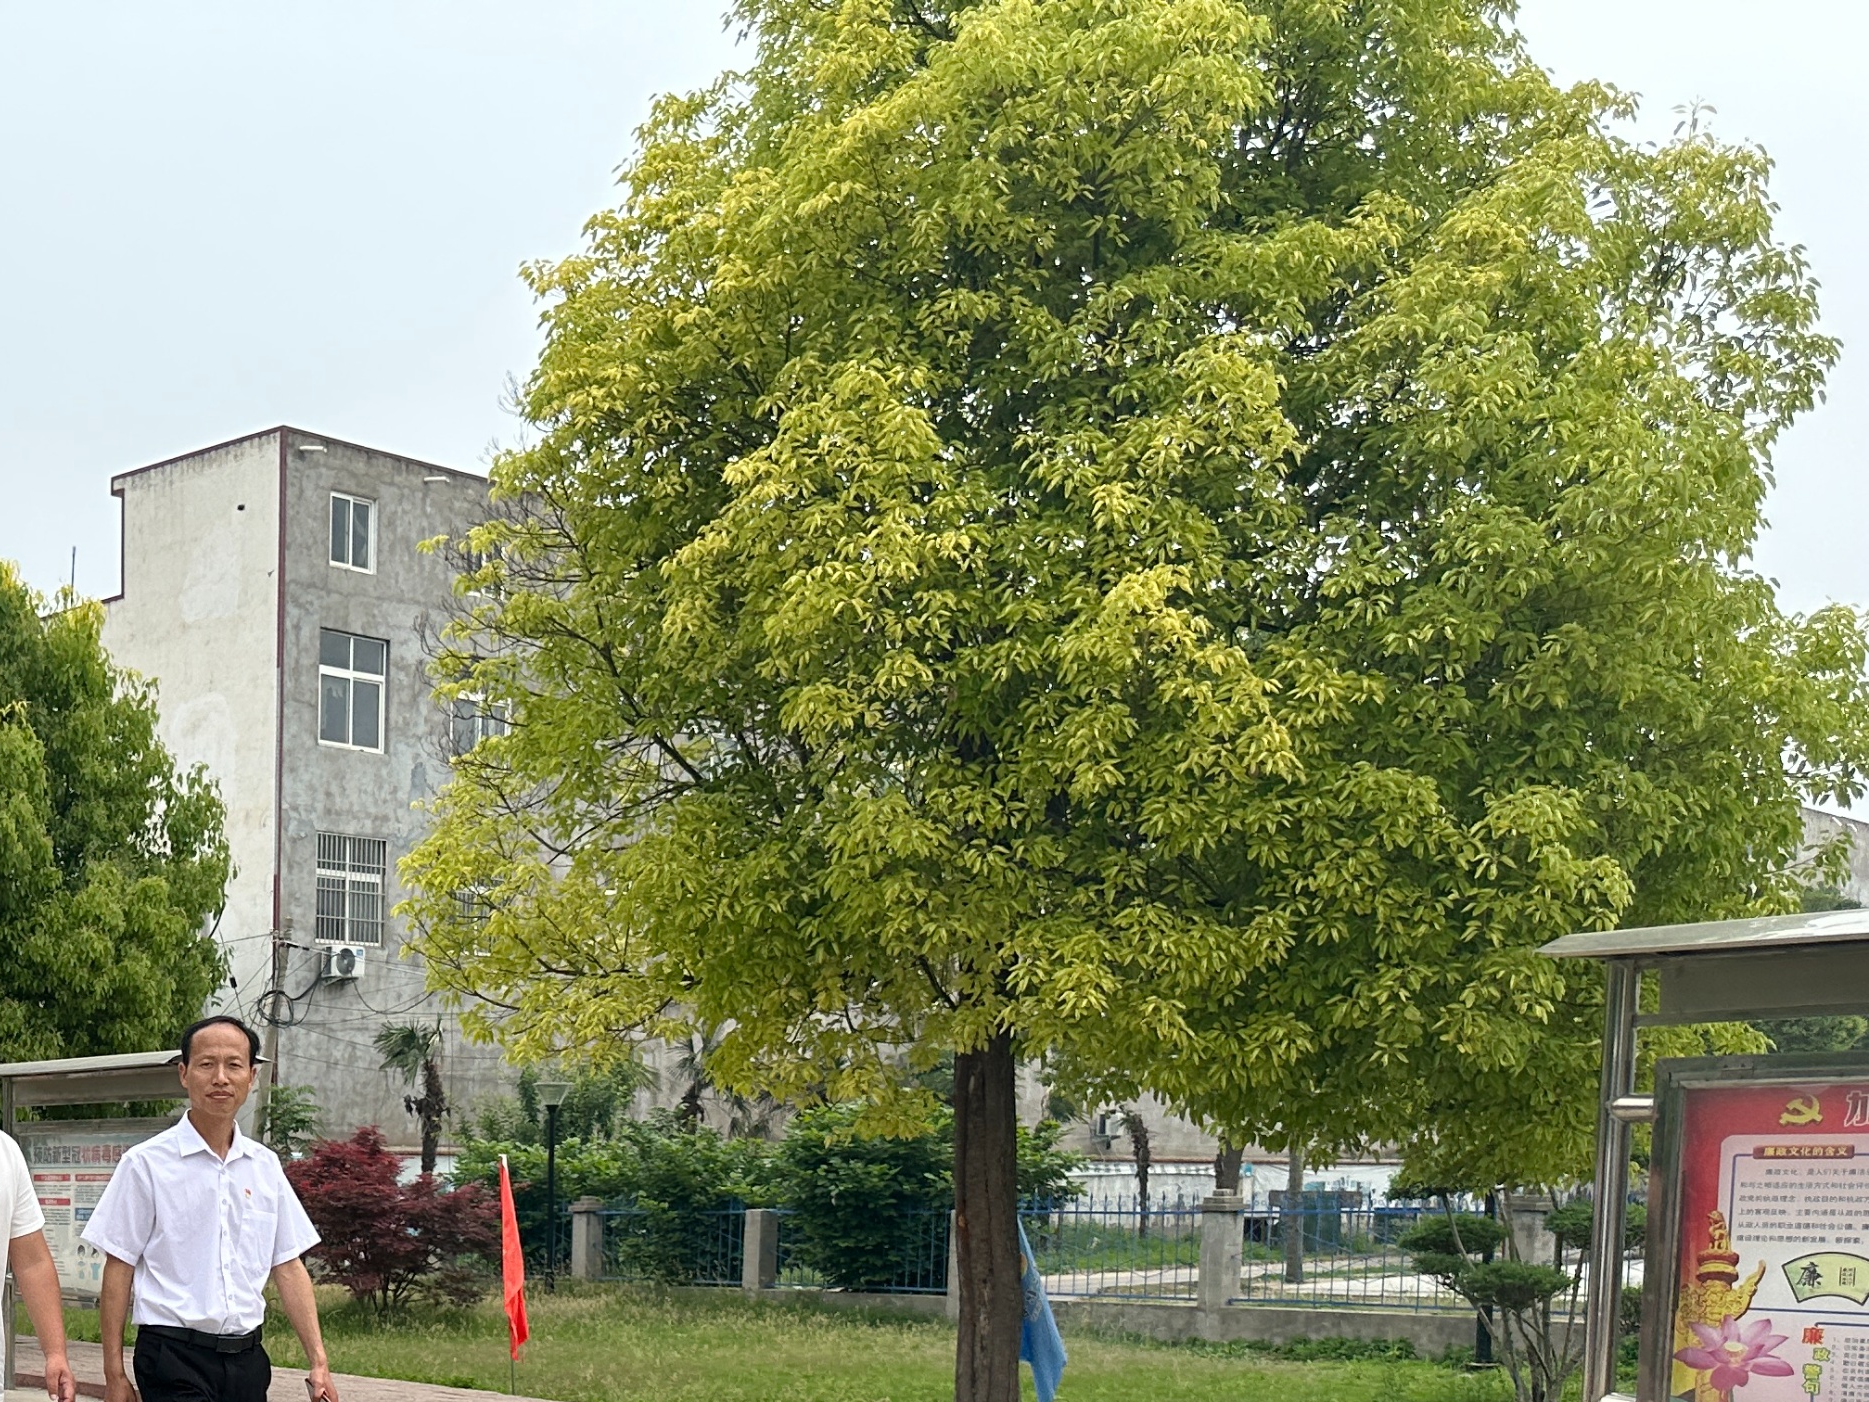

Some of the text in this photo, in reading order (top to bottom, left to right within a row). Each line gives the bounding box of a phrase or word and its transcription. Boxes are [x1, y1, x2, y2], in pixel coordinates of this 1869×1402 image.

[1763, 1146, 1848, 1157] 廉政文化的含义
